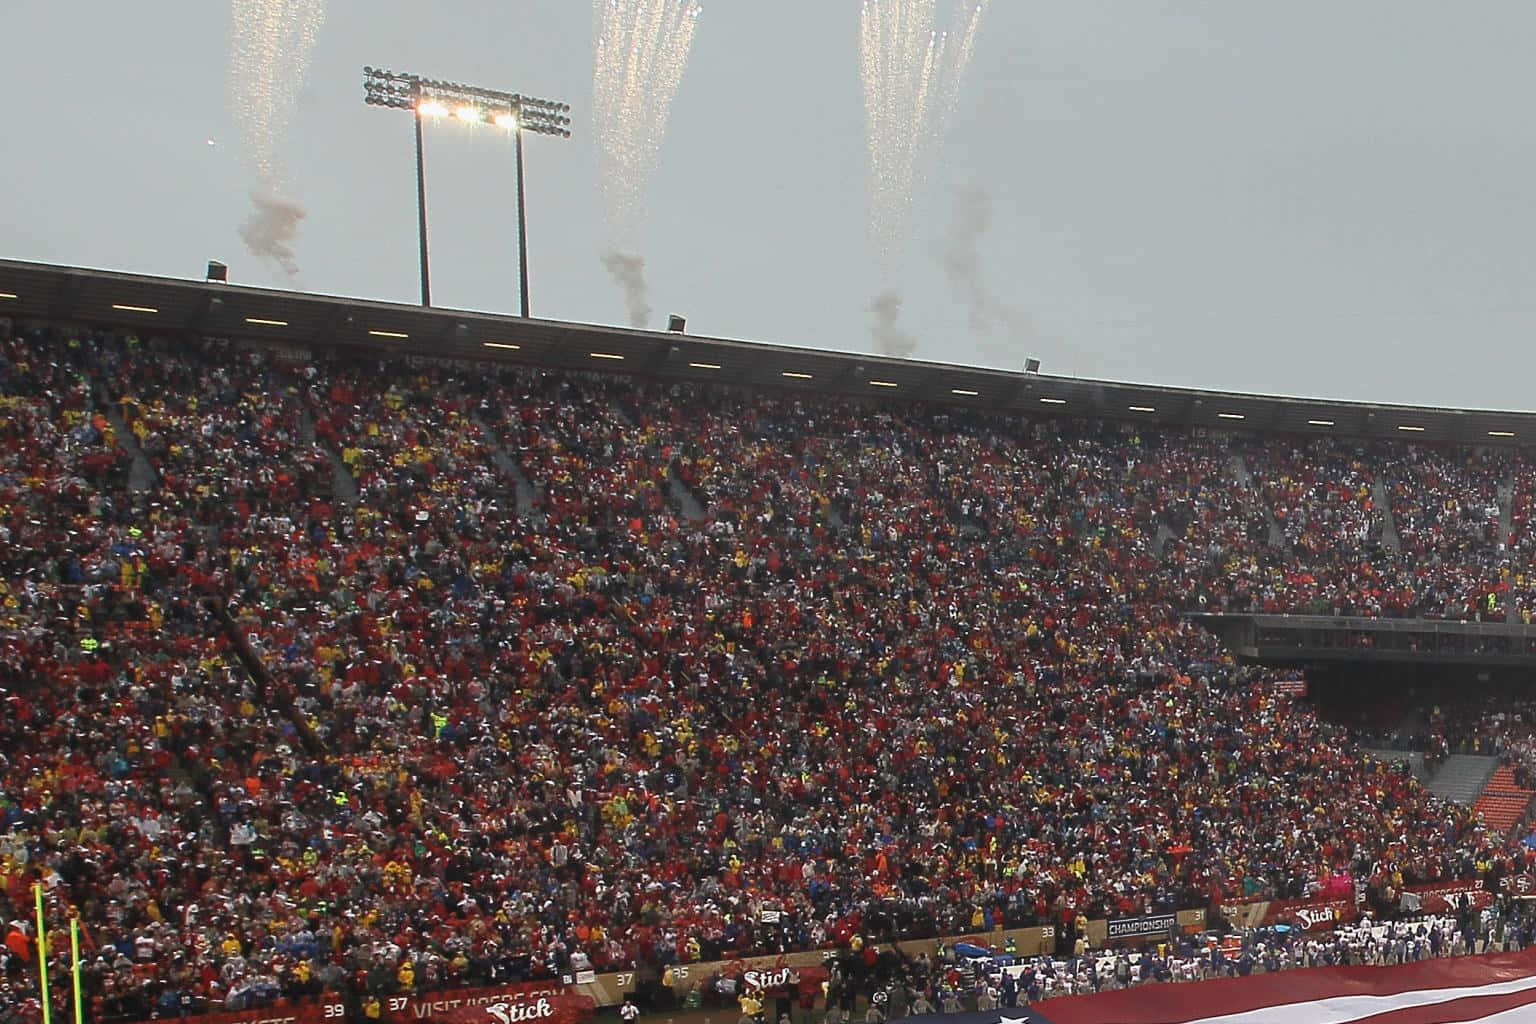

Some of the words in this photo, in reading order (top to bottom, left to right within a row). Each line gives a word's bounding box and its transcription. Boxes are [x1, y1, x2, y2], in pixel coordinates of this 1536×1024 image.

[1109, 918, 1175, 935] CHAMPIONSHIP
[617, 974, 633, 986] 37
[324, 1004, 345, 1017] 39
[389, 998, 408, 1011] 37
